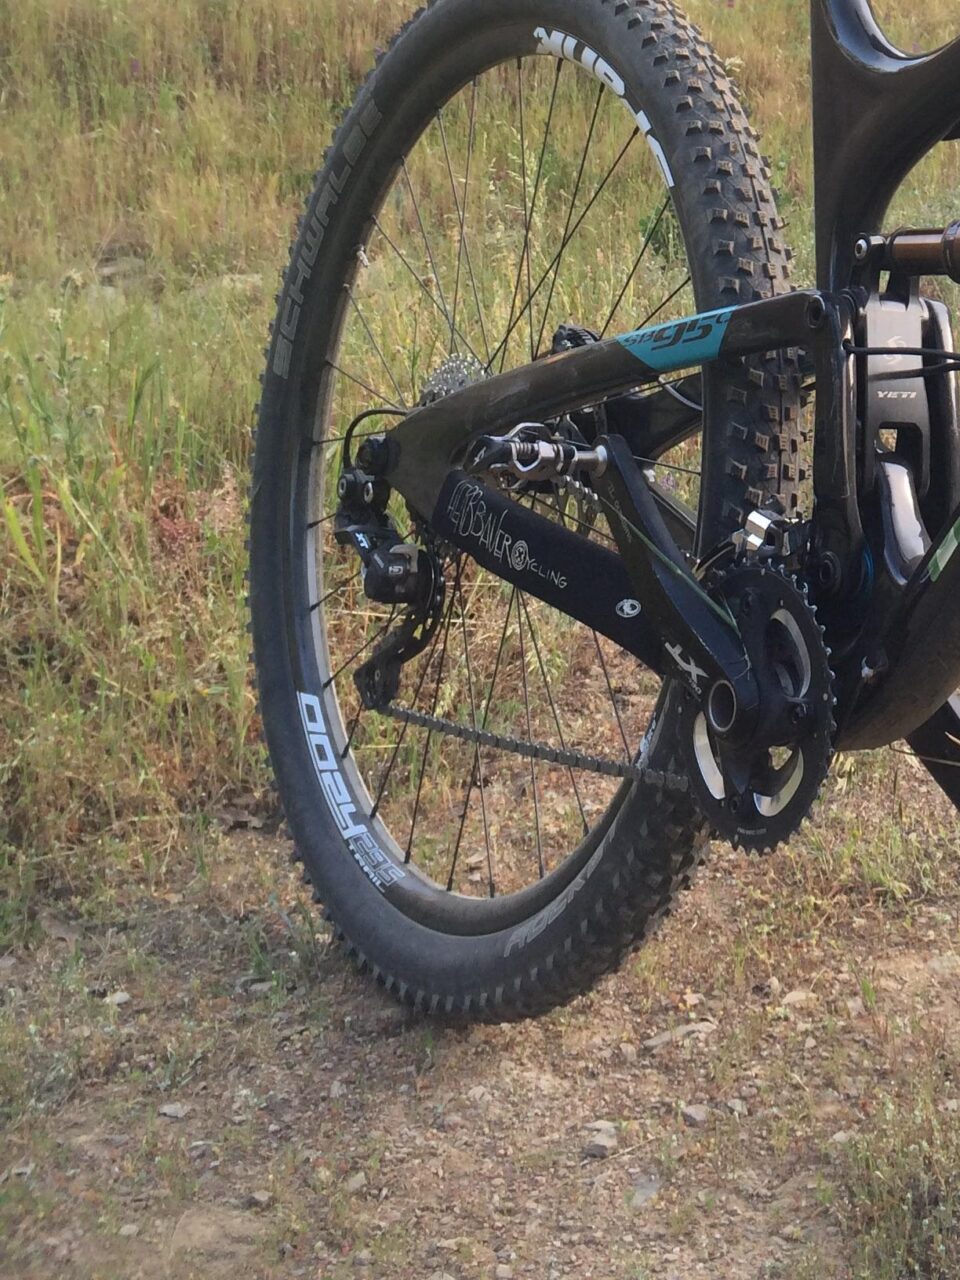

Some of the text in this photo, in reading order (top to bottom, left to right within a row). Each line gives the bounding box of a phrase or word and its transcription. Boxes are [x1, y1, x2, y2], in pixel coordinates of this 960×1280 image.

[272, 99, 384, 380] SCHWALBE
[877, 390, 918, 399] YETI
[347, 842, 386, 894] TRAIL
